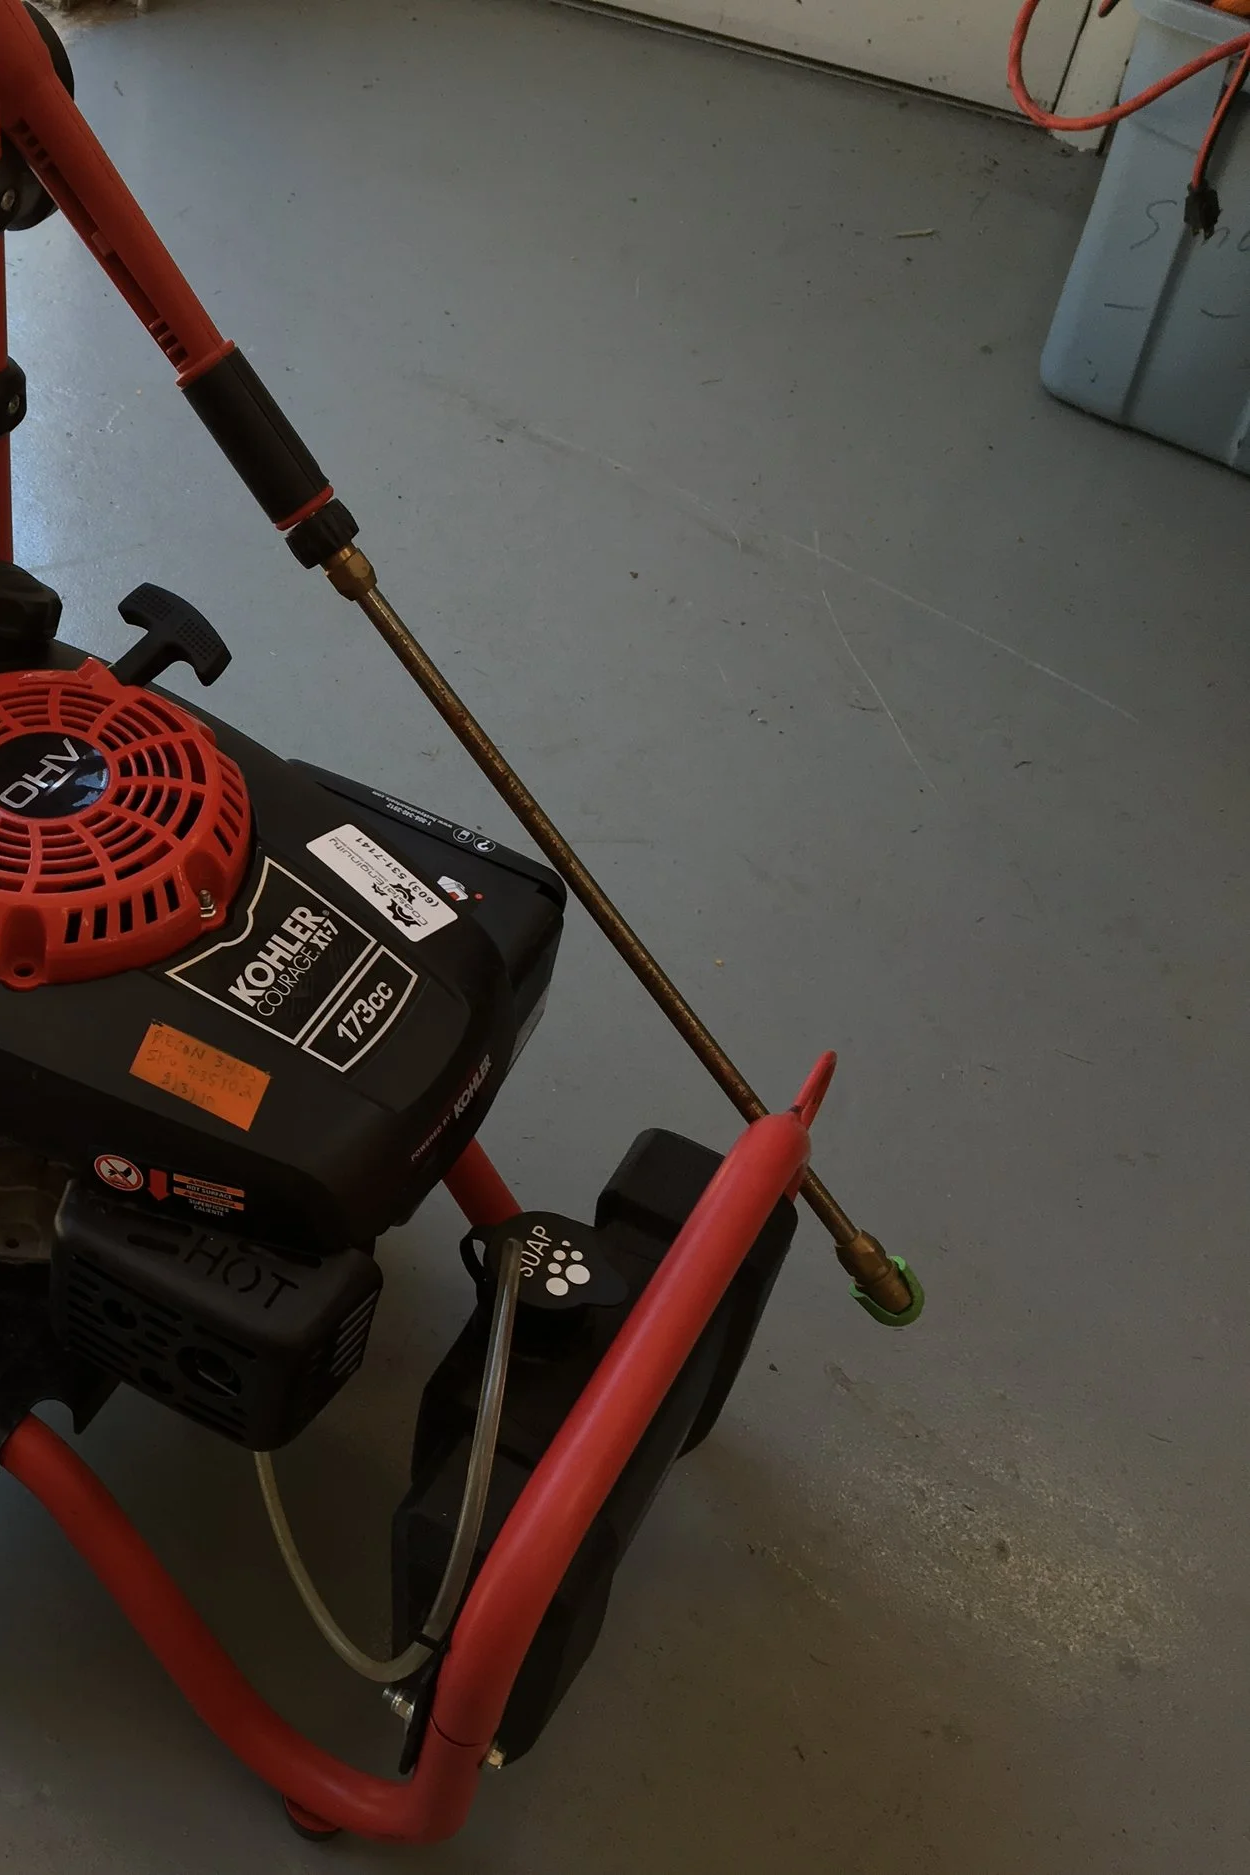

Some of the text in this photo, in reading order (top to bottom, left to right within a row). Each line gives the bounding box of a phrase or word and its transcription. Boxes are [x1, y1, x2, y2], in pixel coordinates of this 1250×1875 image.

[0, 737, 80, 809] OHV
[355, 837, 407, 880] 531-7141
[382, 882, 429, 926] Coastal
[408, 881, 439, 907] (603)
[228, 906, 327, 1007] KOHLER
[256, 919, 339, 1016] COURAGE XT-7
[336, 981, 394, 1043] 173cc
[410, 1124, 442, 1162] POWERED
[453, 1053, 492, 1120] KOHLER
[183, 1234, 300, 1309] HOT
[519, 1225, 553, 1278] SOAP
